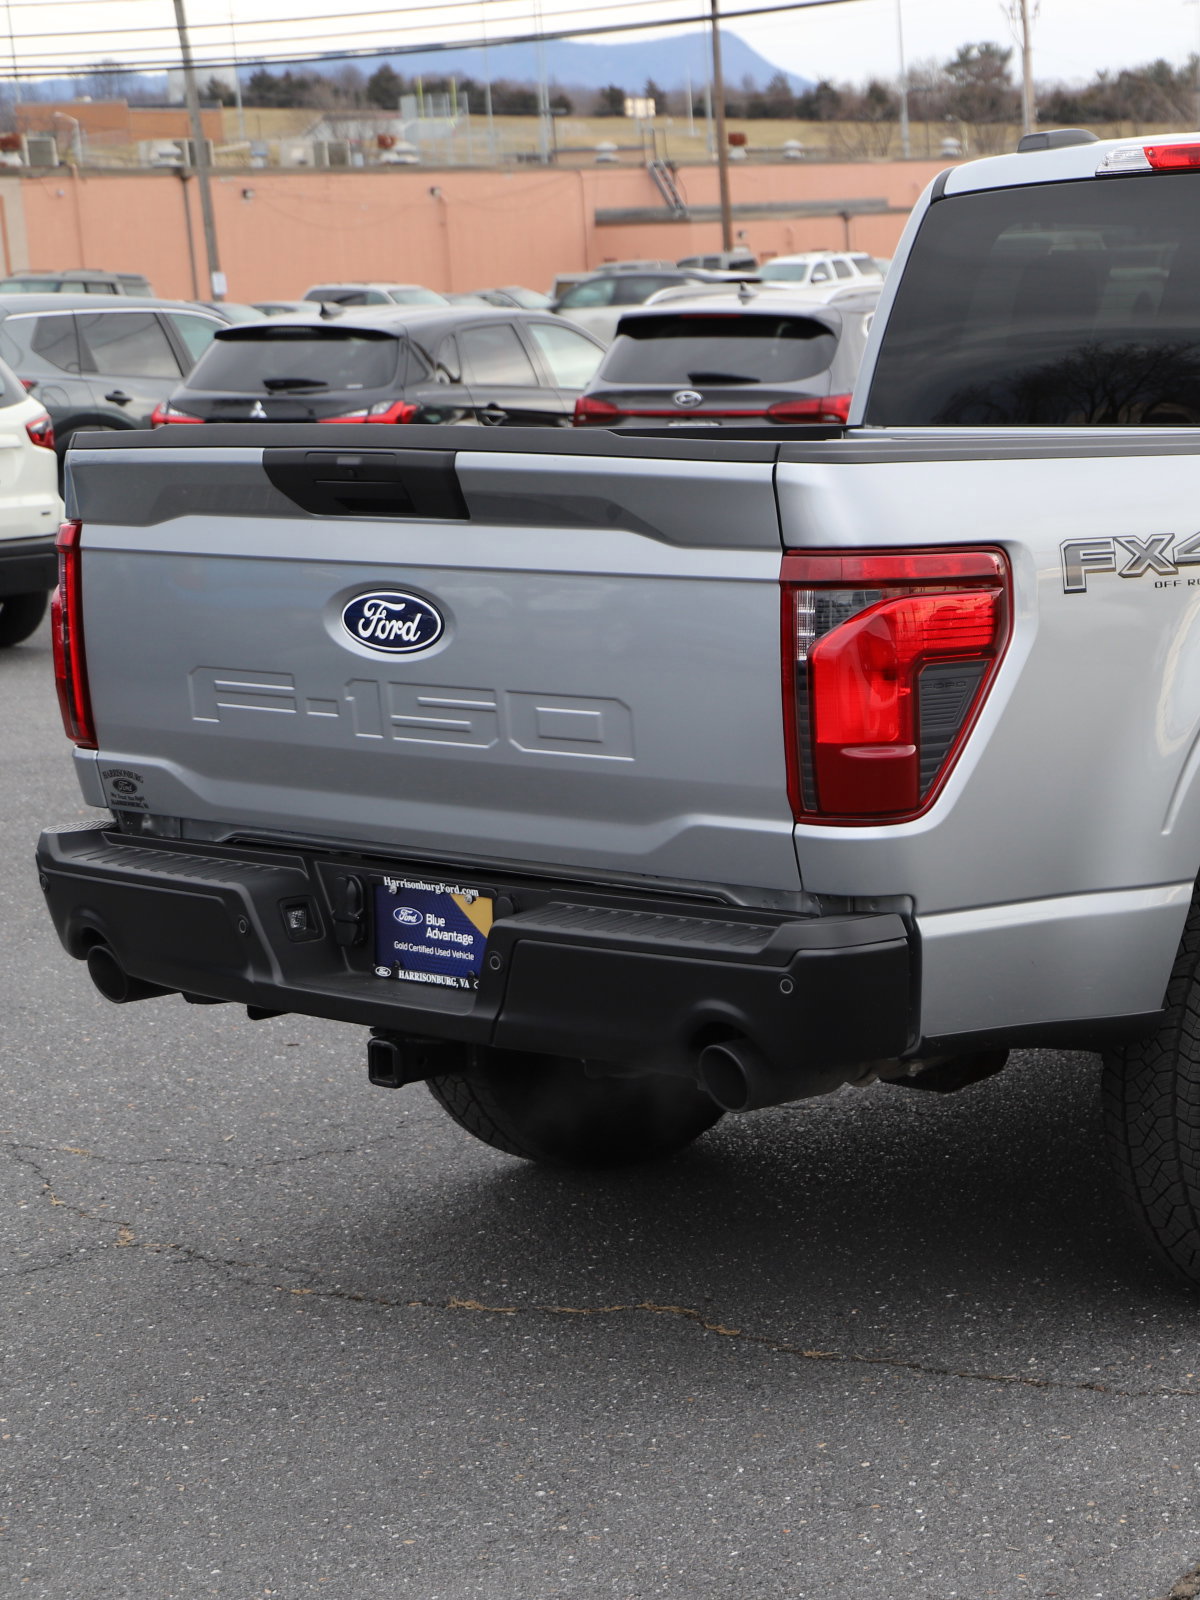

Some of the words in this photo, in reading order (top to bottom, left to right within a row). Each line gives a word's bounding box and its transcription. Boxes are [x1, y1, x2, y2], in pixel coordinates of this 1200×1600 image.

[1154, 579, 1182, 589] OFF
[357, 599, 421, 642] Ford
[187, 665, 635, 762] F-150
[383, 876, 479, 897] HarrisonburgFord.com
[398, 908, 418, 923] Ford
[426, 913, 446, 927] Blue
[426, 927, 474, 945] Advantage
[394, 941, 408, 951] Gold
[408, 943, 434, 955] Certified
[434, 947, 451, 958] Used
[452, 950, 475, 961] Vehicle
[398, 970, 459, 988] HARRISONBURG,
[460, 979, 470, 988] VA
